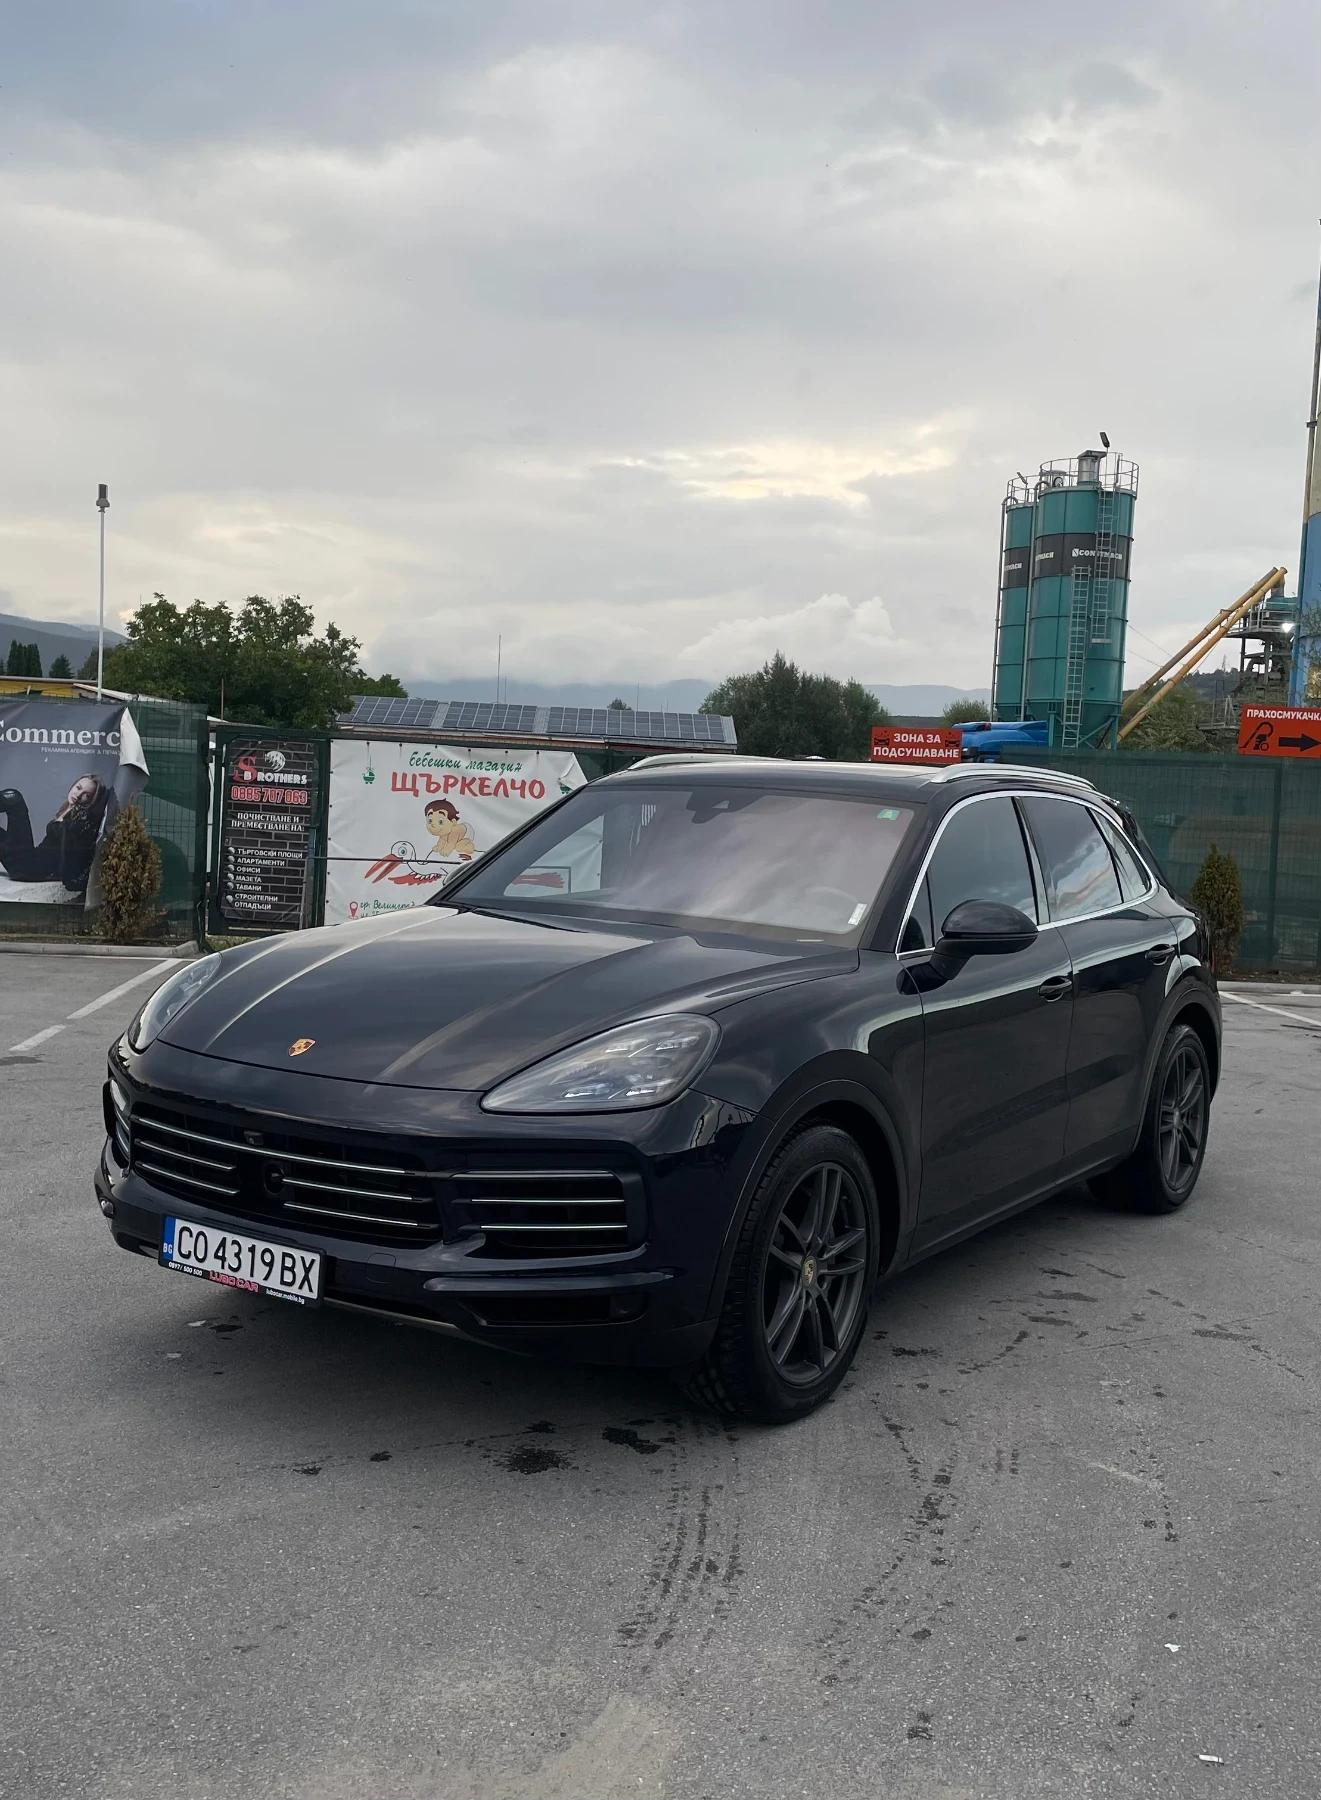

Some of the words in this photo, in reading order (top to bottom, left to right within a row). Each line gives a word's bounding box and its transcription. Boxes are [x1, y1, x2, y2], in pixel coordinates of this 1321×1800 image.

[1247, 709, 1321, 721] ПРАХОСМУКАЧК
[893, 733, 924, 743] ЗОНА
[926, 734, 941, 744] ЗА
[873, 747, 959, 758] ПОДСУШАВАНЕ
[409, 751, 462, 769] бебешки
[465, 760, 523, 776] магазин
[391, 771, 546, 800] ЩЪРКЕЛЧО
[231, 785, 261, 802] 0885
[262, 788, 284, 804] 707
[285, 789, 308, 805] 063
[237, 812, 292, 822] ПОЧИСТВАНЕ
[231, 820, 290, 832] ПРЕМЕСТВАНЕ
[237, 848, 277, 858] ТЪРГОВСКИ
[277, 851, 303, 859] ПЛОЩИ
[237, 857, 285, 867] АПАРТАМЕНТИ
[236, 866, 261, 874] ОФИСИ
[235, 875, 262, 883] МАЗЕТА
[235, 884, 262, 892] ТАВАНИ
[234, 893, 278, 902] СТРОИТЕЛНИ
[234, 901, 272, 911] ОТПАДЪЦИ
[162, 1242, 173, 1254] BG
[178, 1226, 208, 1264] CO
[213, 1236, 275, 1282] 4319
[279, 1251, 316, 1293] BX
[236, 1278, 259, 1293] CAR
